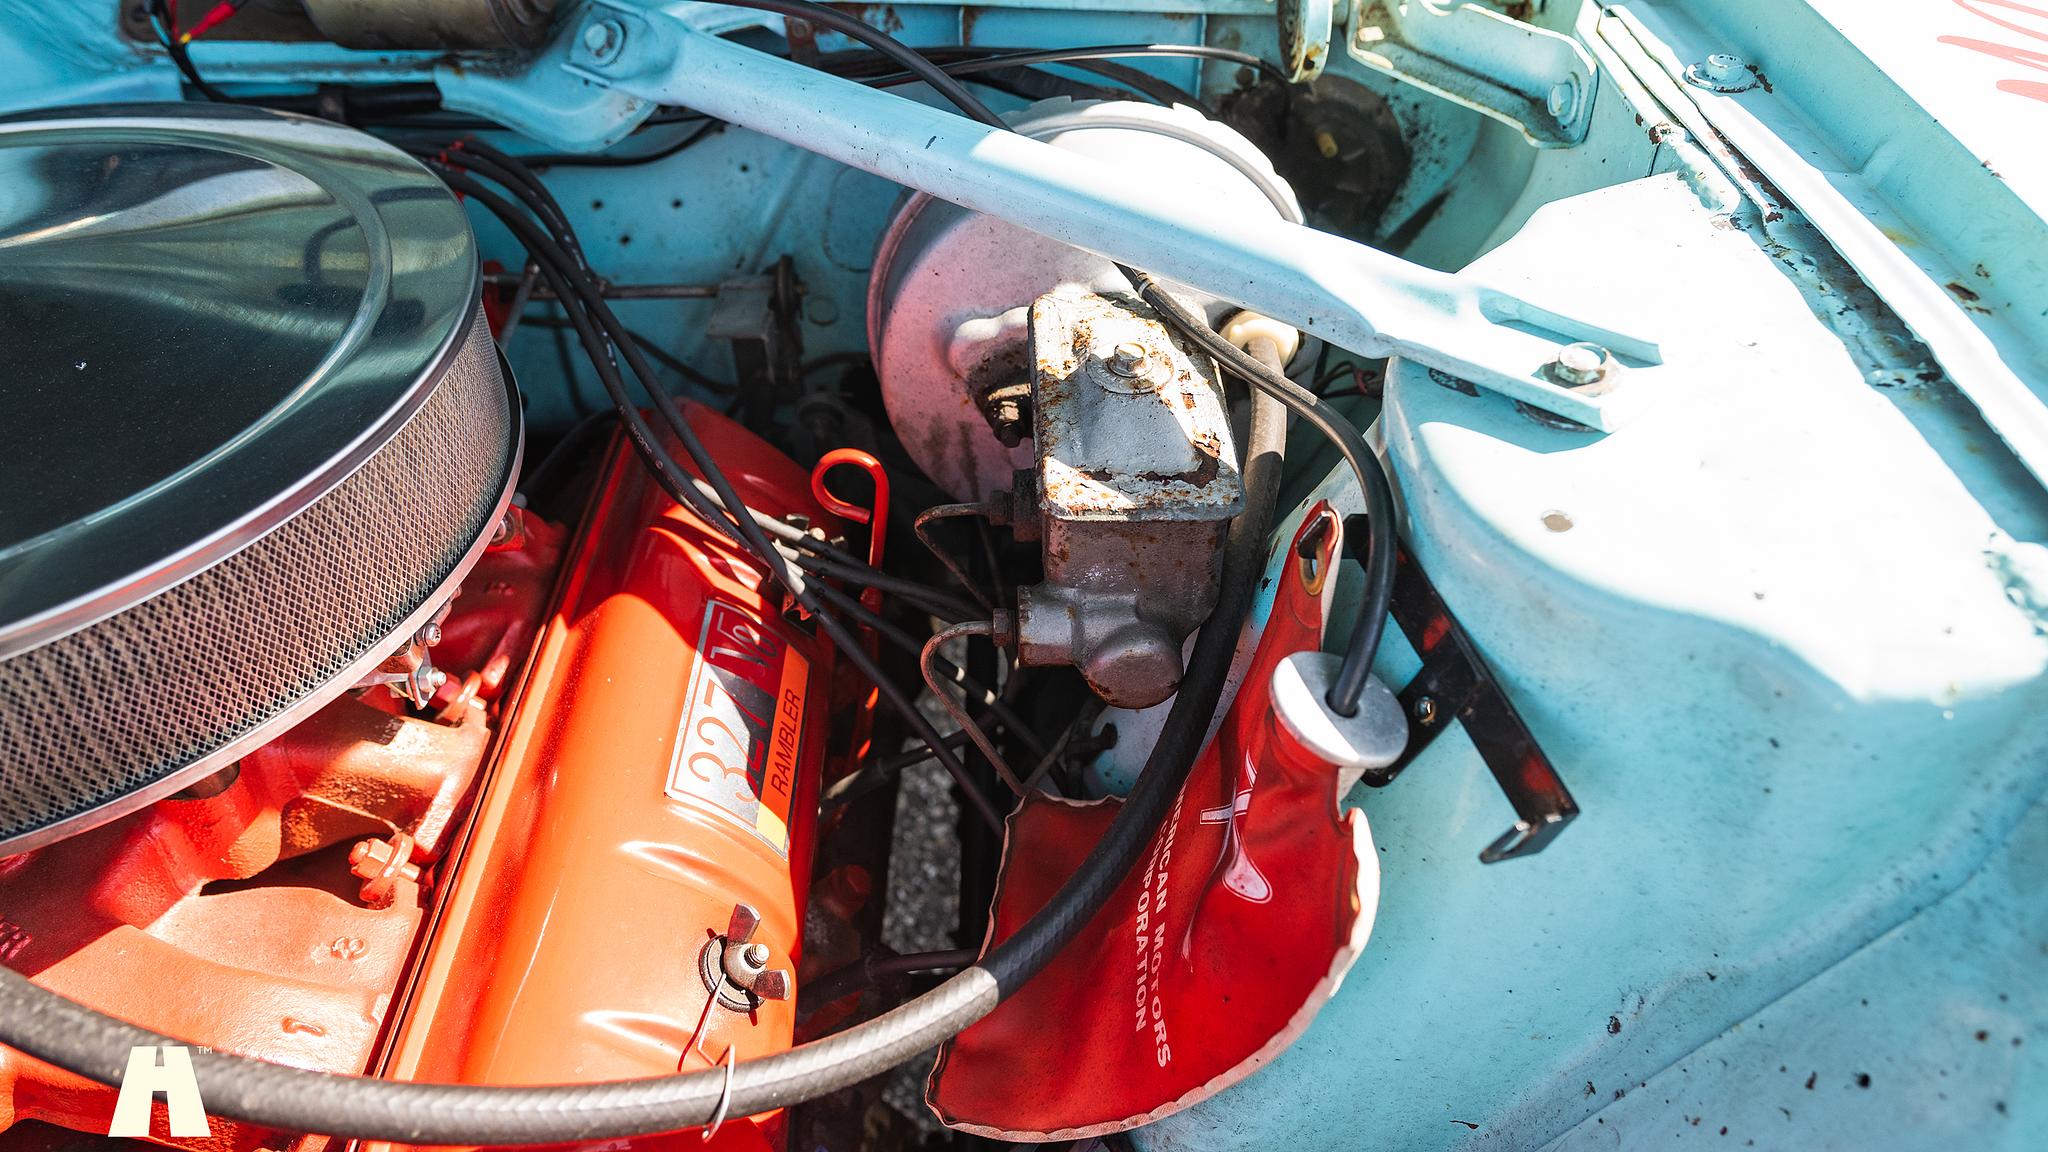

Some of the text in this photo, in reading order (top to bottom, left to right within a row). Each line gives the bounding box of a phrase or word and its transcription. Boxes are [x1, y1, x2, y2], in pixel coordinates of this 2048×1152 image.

[688, 612, 779, 803] 327 V8
[771, 688, 801, 797] RAMBLER
[1135, 820, 1168, 1032] CORPORATION
[1150, 783, 1187, 1068] MERICAN MOTORS
